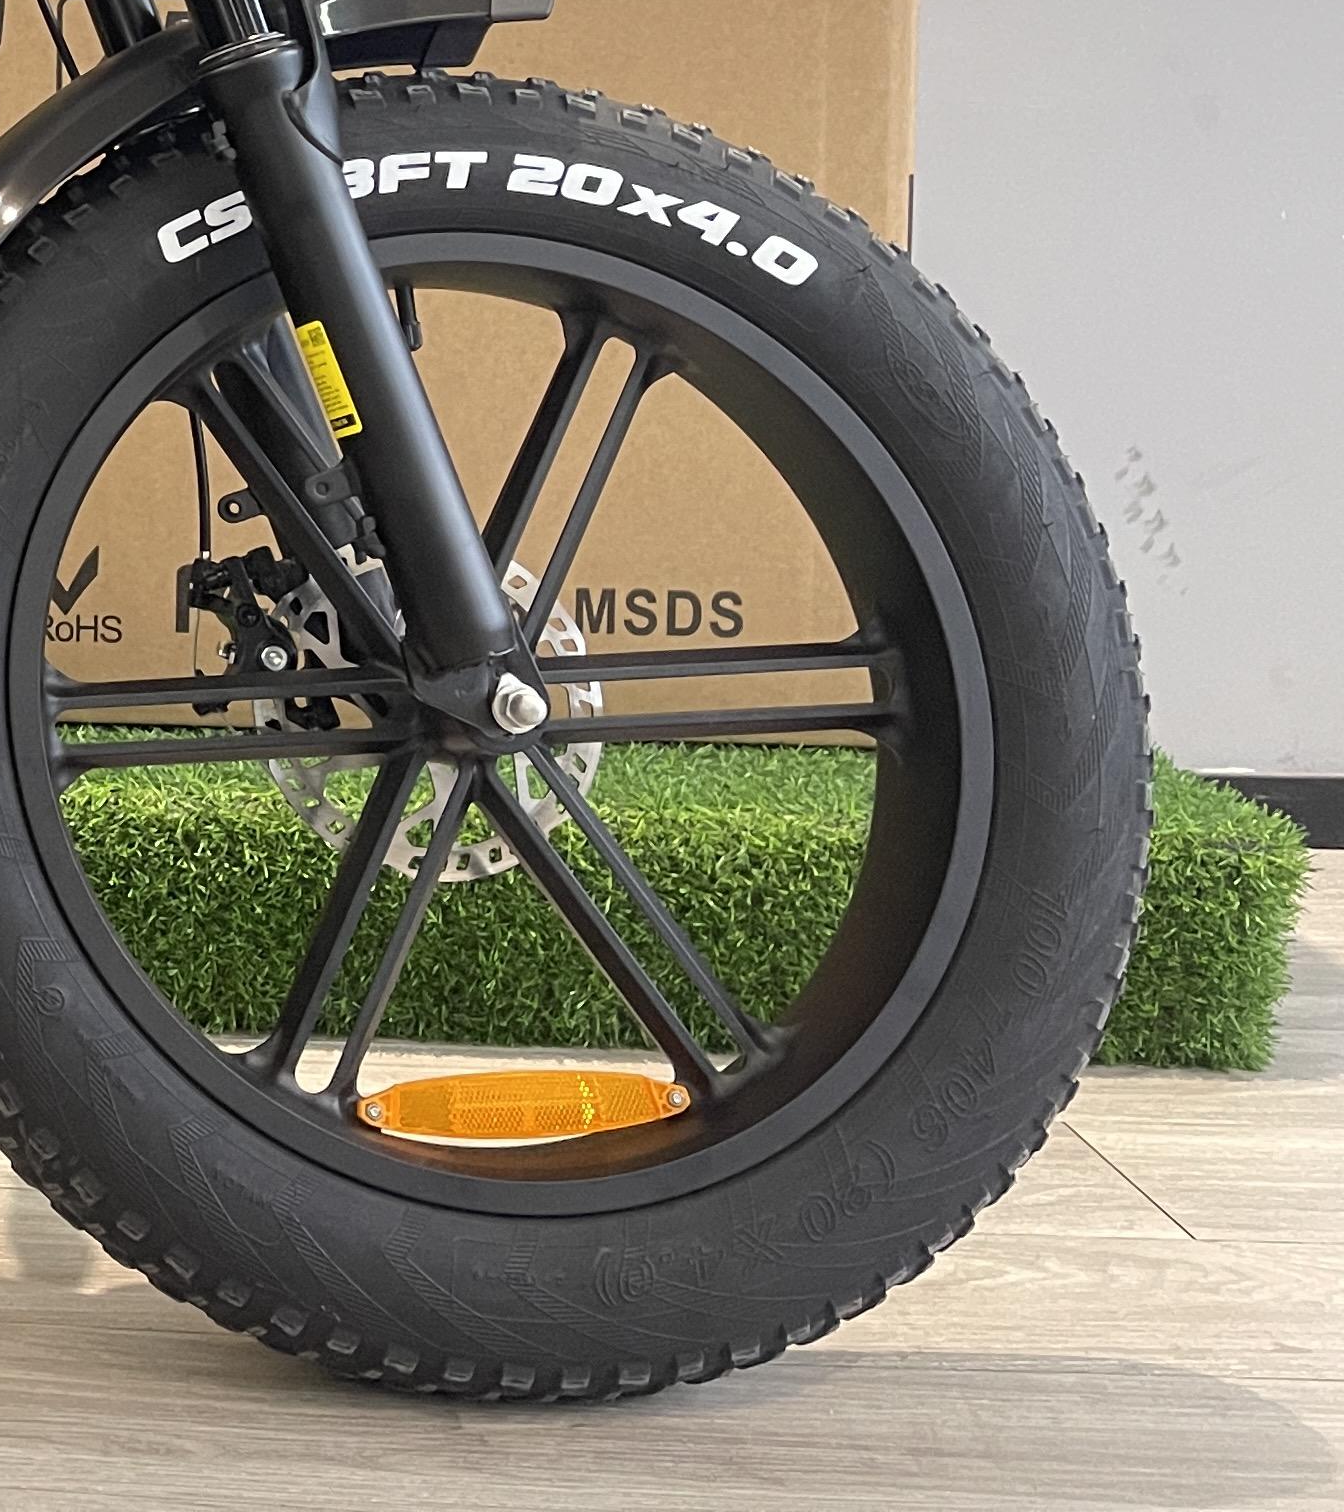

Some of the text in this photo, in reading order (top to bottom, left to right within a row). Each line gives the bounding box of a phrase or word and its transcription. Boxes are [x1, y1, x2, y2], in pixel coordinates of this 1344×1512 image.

[157, 149, 820, 289] CS BFT 20x4.0
[575, 587, 744, 639] MSDS
